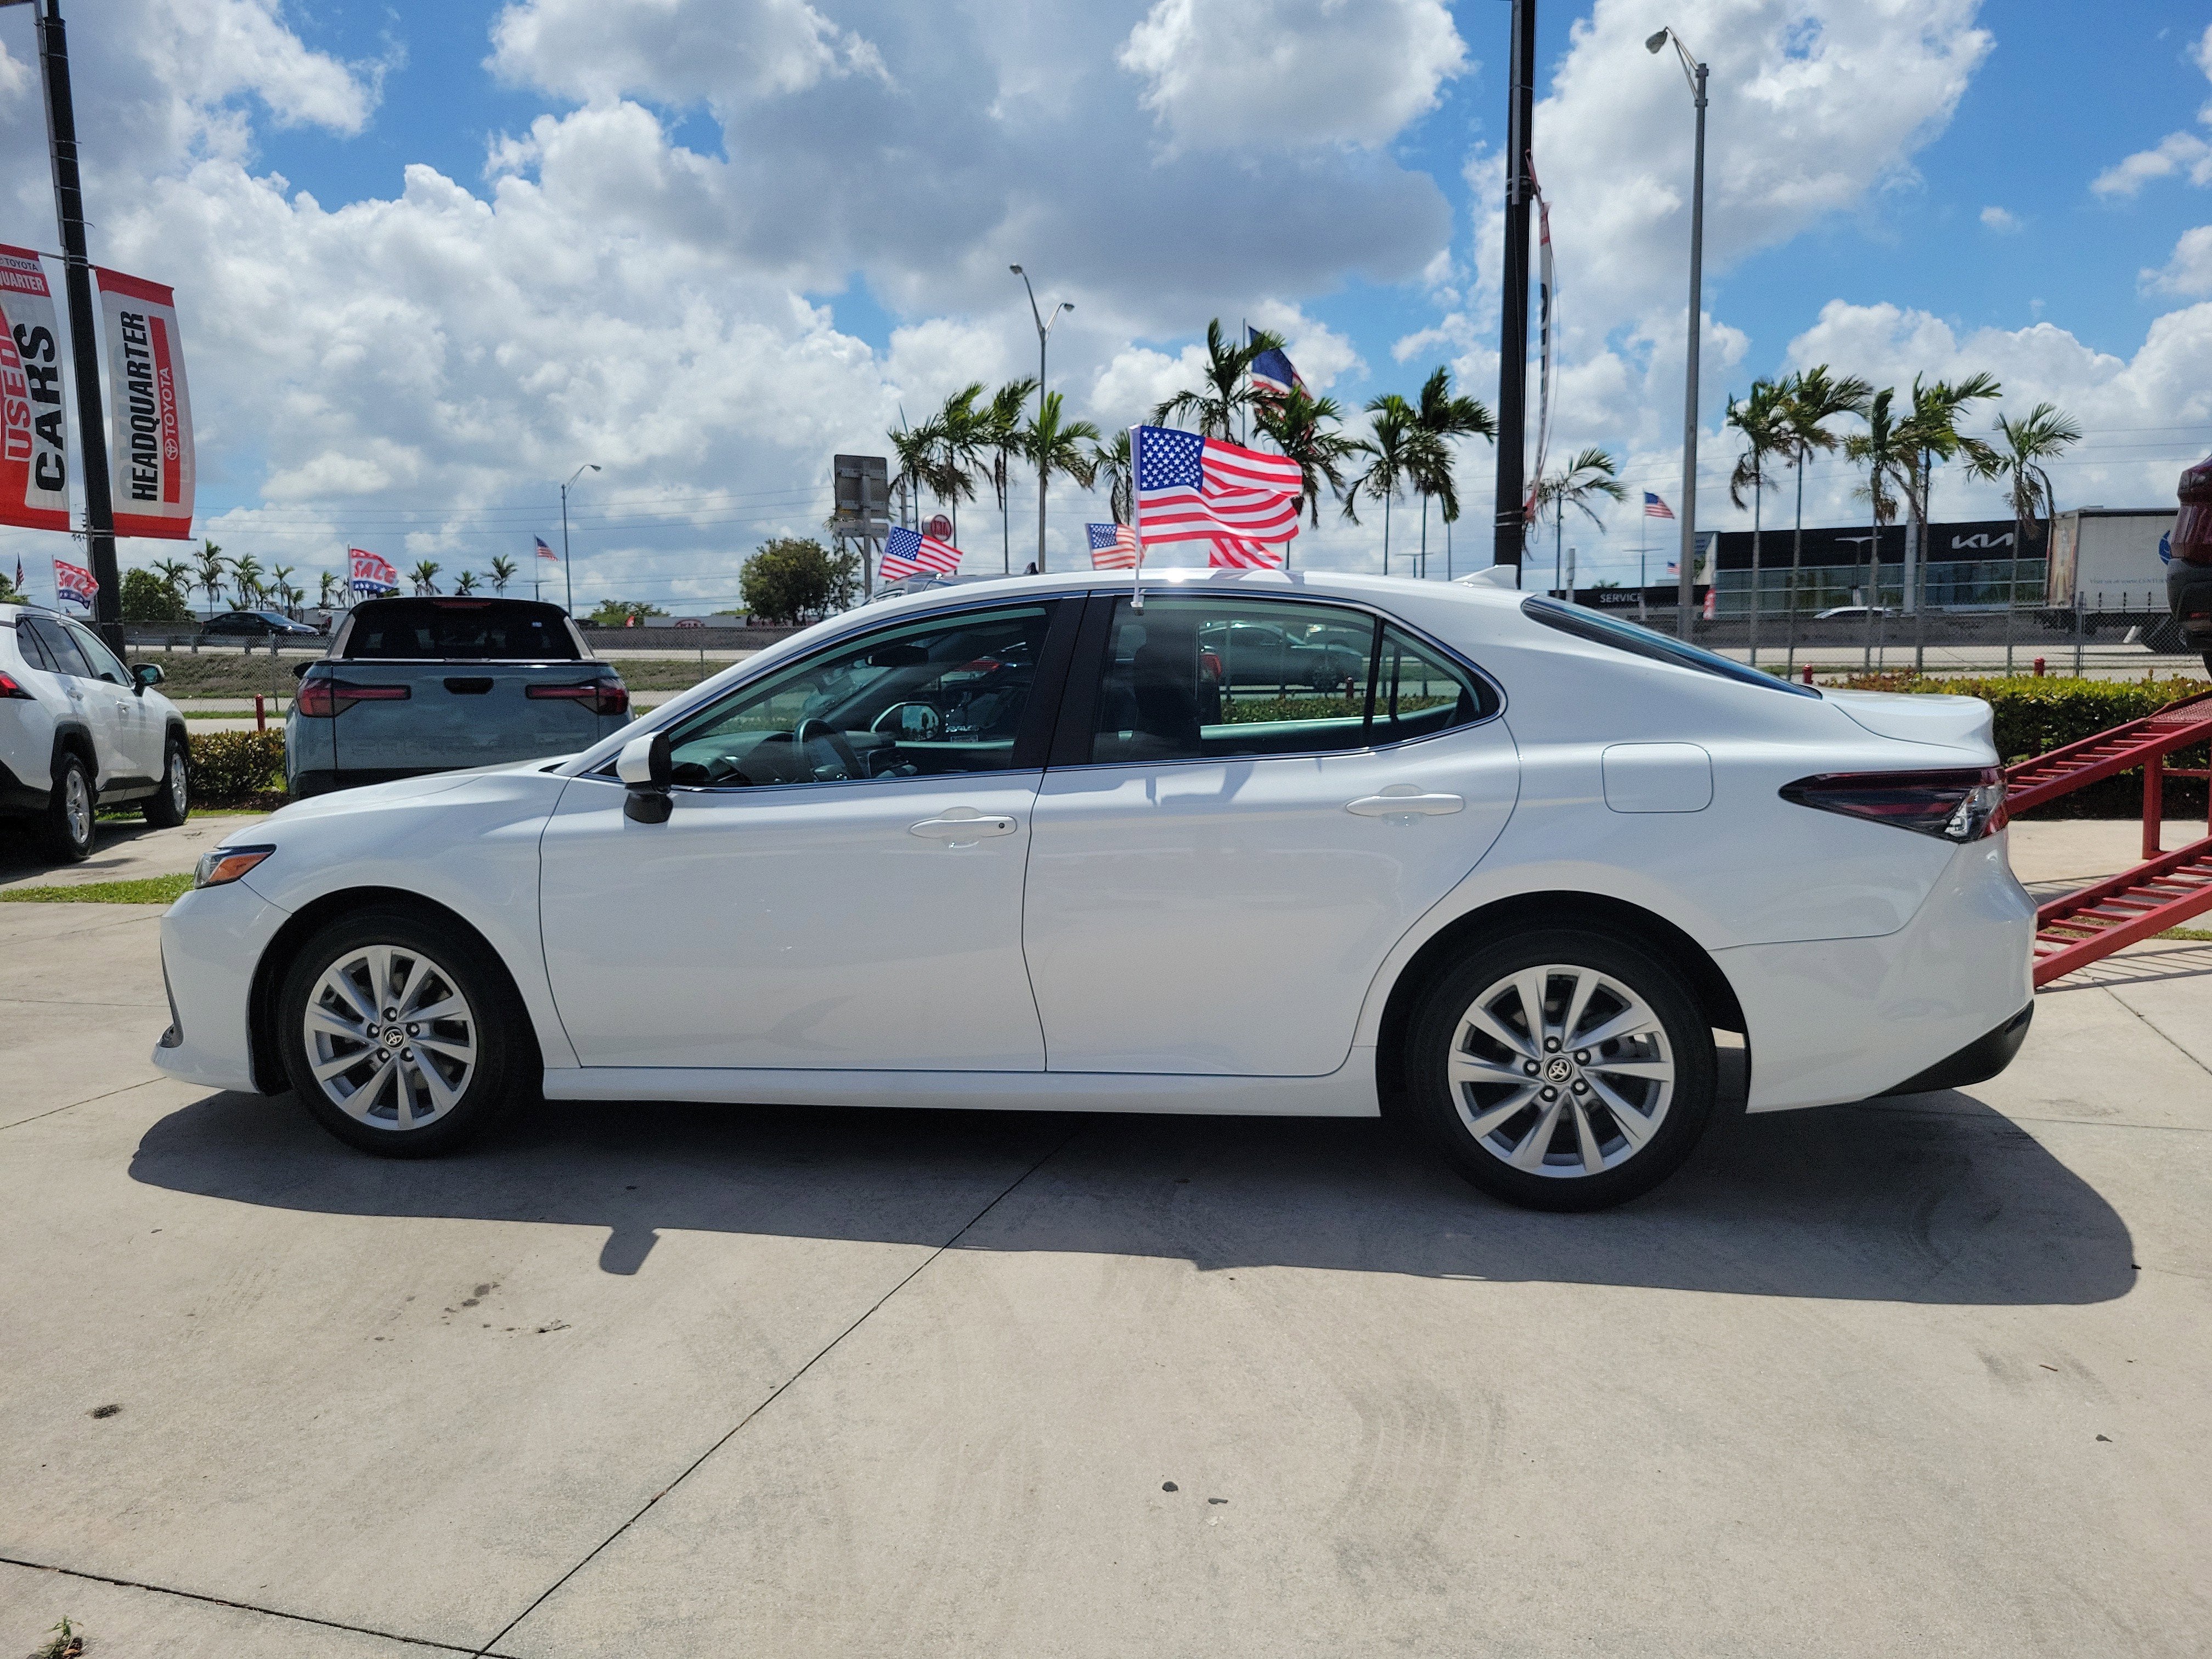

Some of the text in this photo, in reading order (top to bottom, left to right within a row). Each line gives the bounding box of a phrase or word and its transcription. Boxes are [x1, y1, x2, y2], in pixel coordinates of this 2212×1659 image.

[3, 257, 39, 272] TOYOTA
[1, 336, 33, 462] USED
[13, 323, 65, 491] CARS
[121, 311, 160, 501] HEADQUARTER
[160, 368, 175, 436] TOYOTA
[354, 561, 396, 584] SALE
[1951, 533, 2013, 549] KIA
